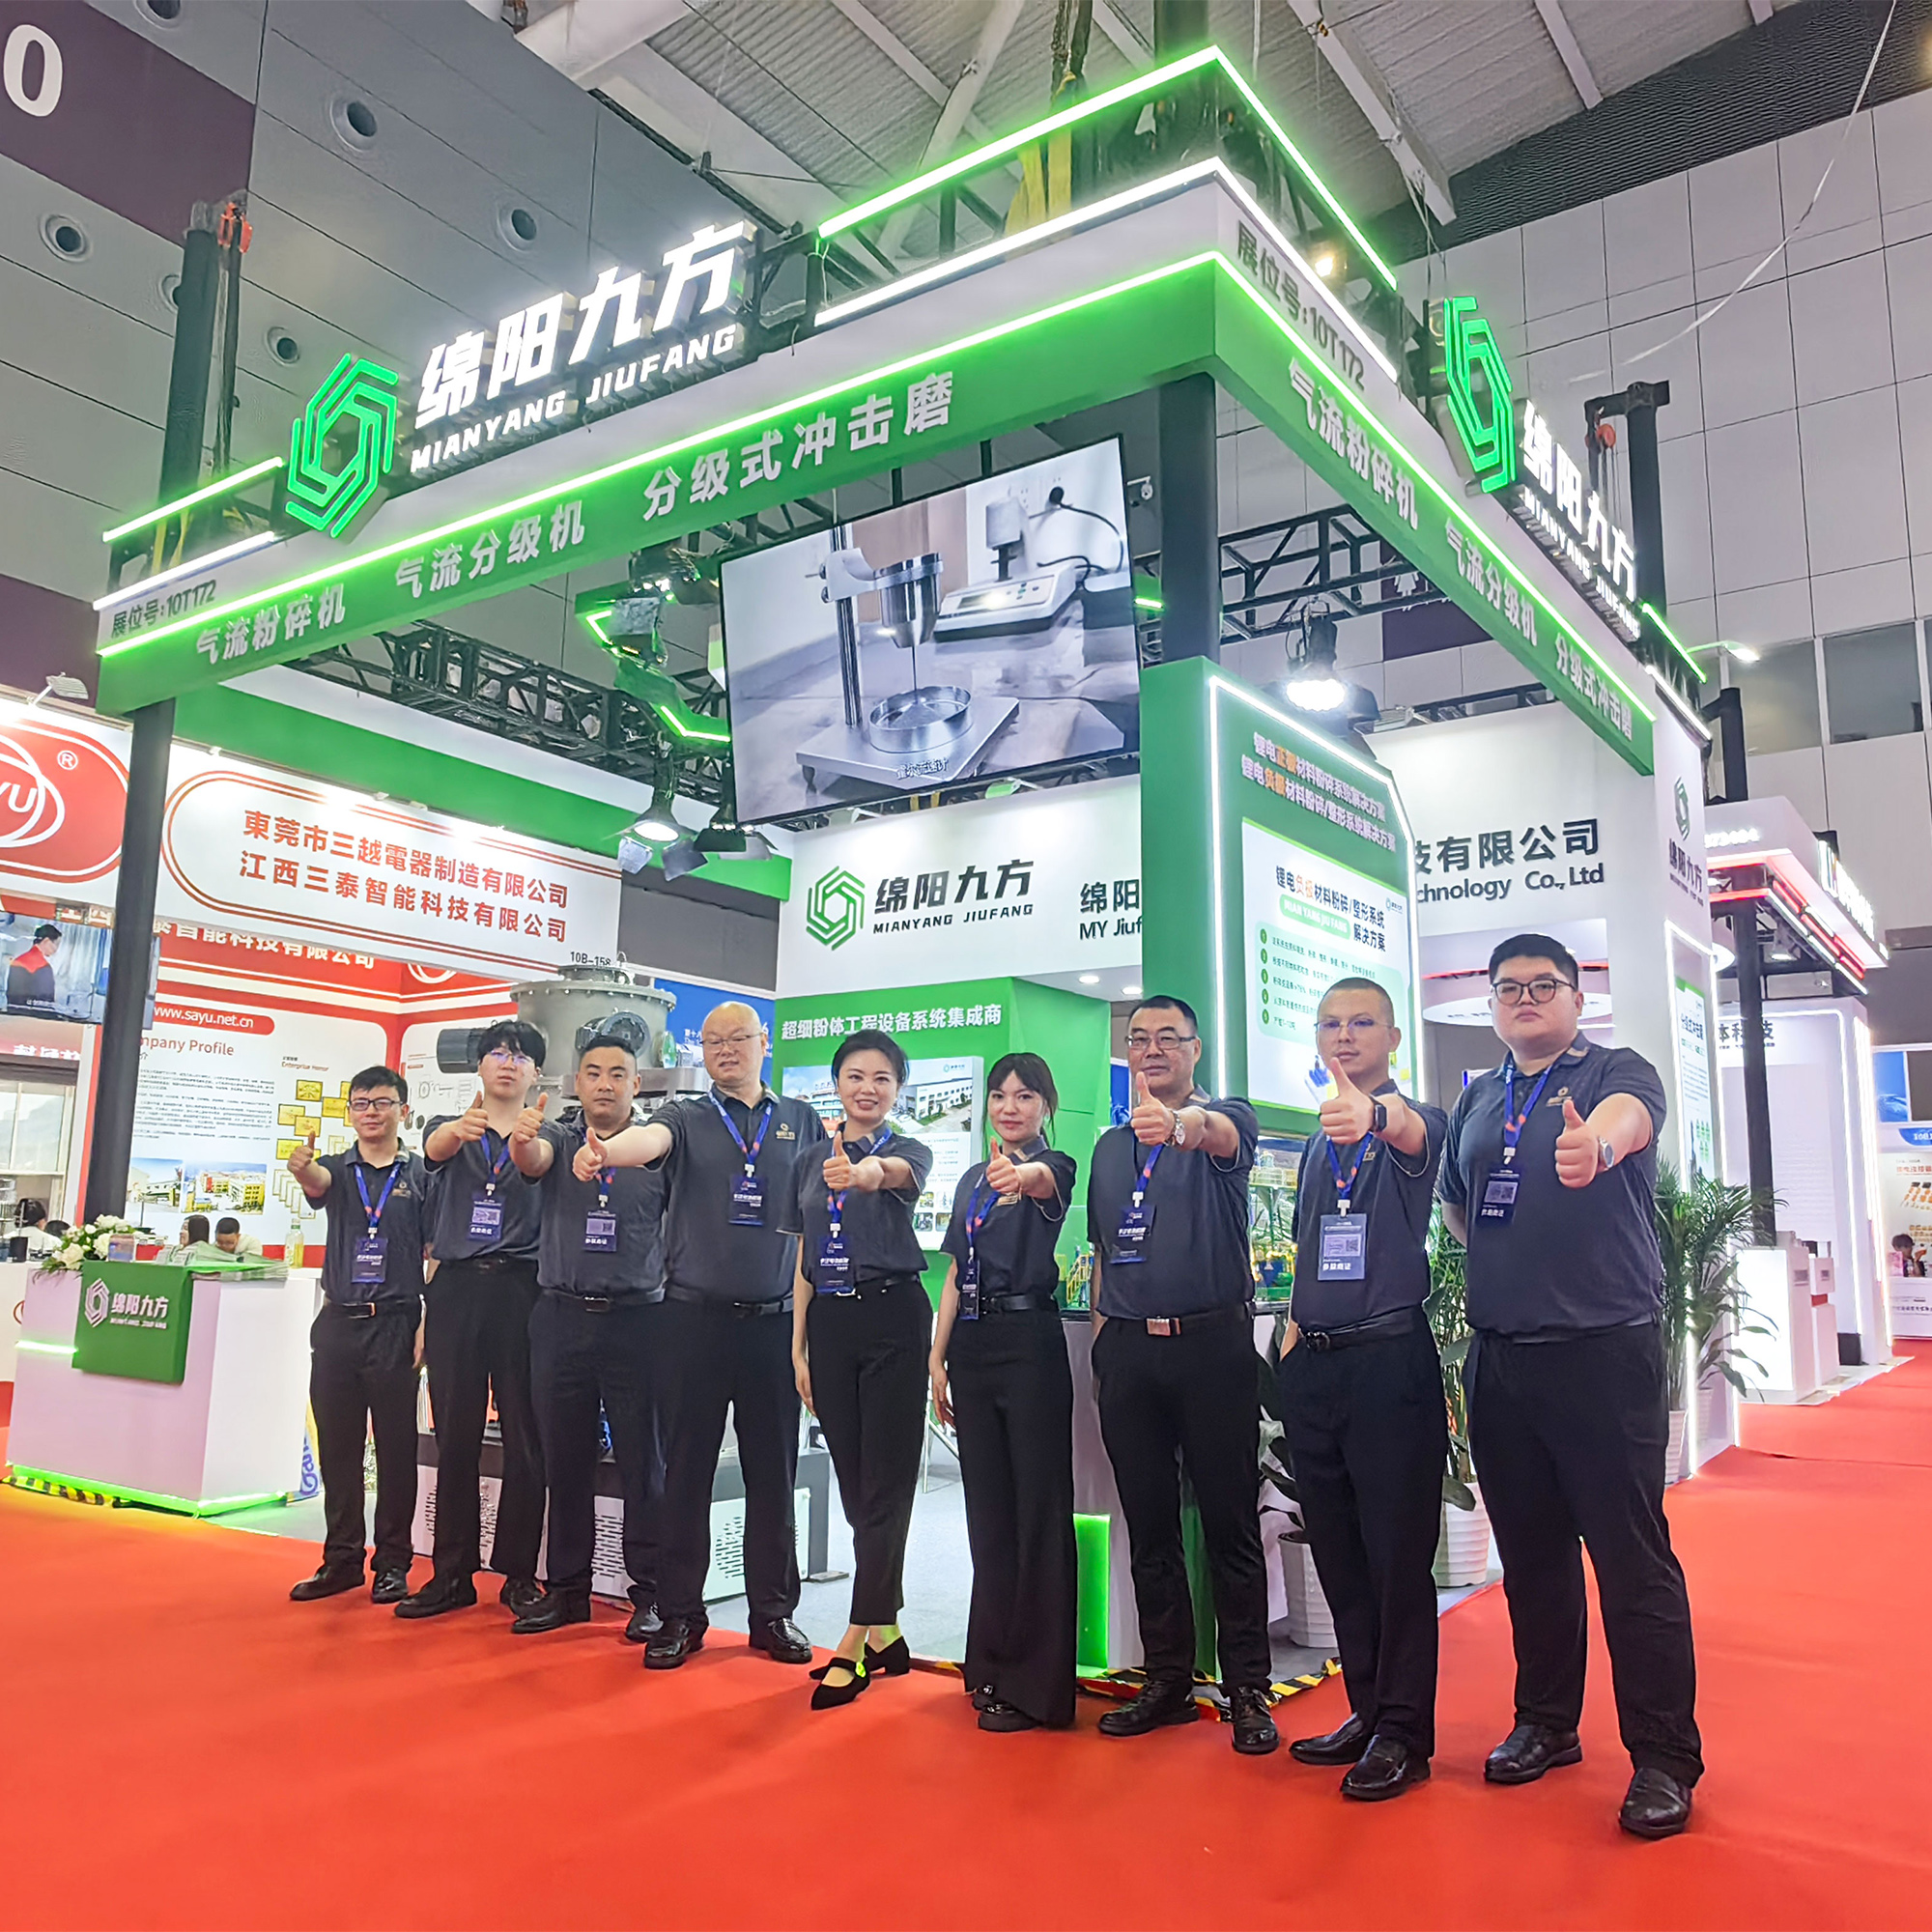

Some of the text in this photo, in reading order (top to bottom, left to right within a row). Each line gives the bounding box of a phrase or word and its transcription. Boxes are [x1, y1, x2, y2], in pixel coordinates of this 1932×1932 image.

[415, 220, 745, 430] 绵阳九方
[411, 323, 738, 473] MIANYANG JIUFANG
[1289, 356, 1418, 530] 气流粉碎机
[642, 371, 953, 522] 分级式冲击磨
[1523, 398, 1636, 603] 绵阳九方
[395, 499, 585, 601] 气流分级机
[1444, 517, 1538, 647] 气流分级机
[196, 582, 346, 665] 气流粉碎机
[1555, 632, 1633, 742] 分级式冲击磨
[240, 850, 567, 943] 江西三泰智能科技有限公司
[243, 810, 568, 910] 東莞市三越電器制造有限公司
[874, 859, 1034, 915] 绵阳九方
[1080, 879, 1140, 914] 绵阳
[873, 904, 1034, 935] MIANYANG JIUFANG
[1079, 920, 1108, 939] MY
[1353, 923, 1386, 952] 解决方案
[189, 1040, 235, 1056] Profile
[781, 1003, 1002, 1040] 超细粉体工程设备系统集成商
[111, 1293, 169, 1319] 绵阳九方
